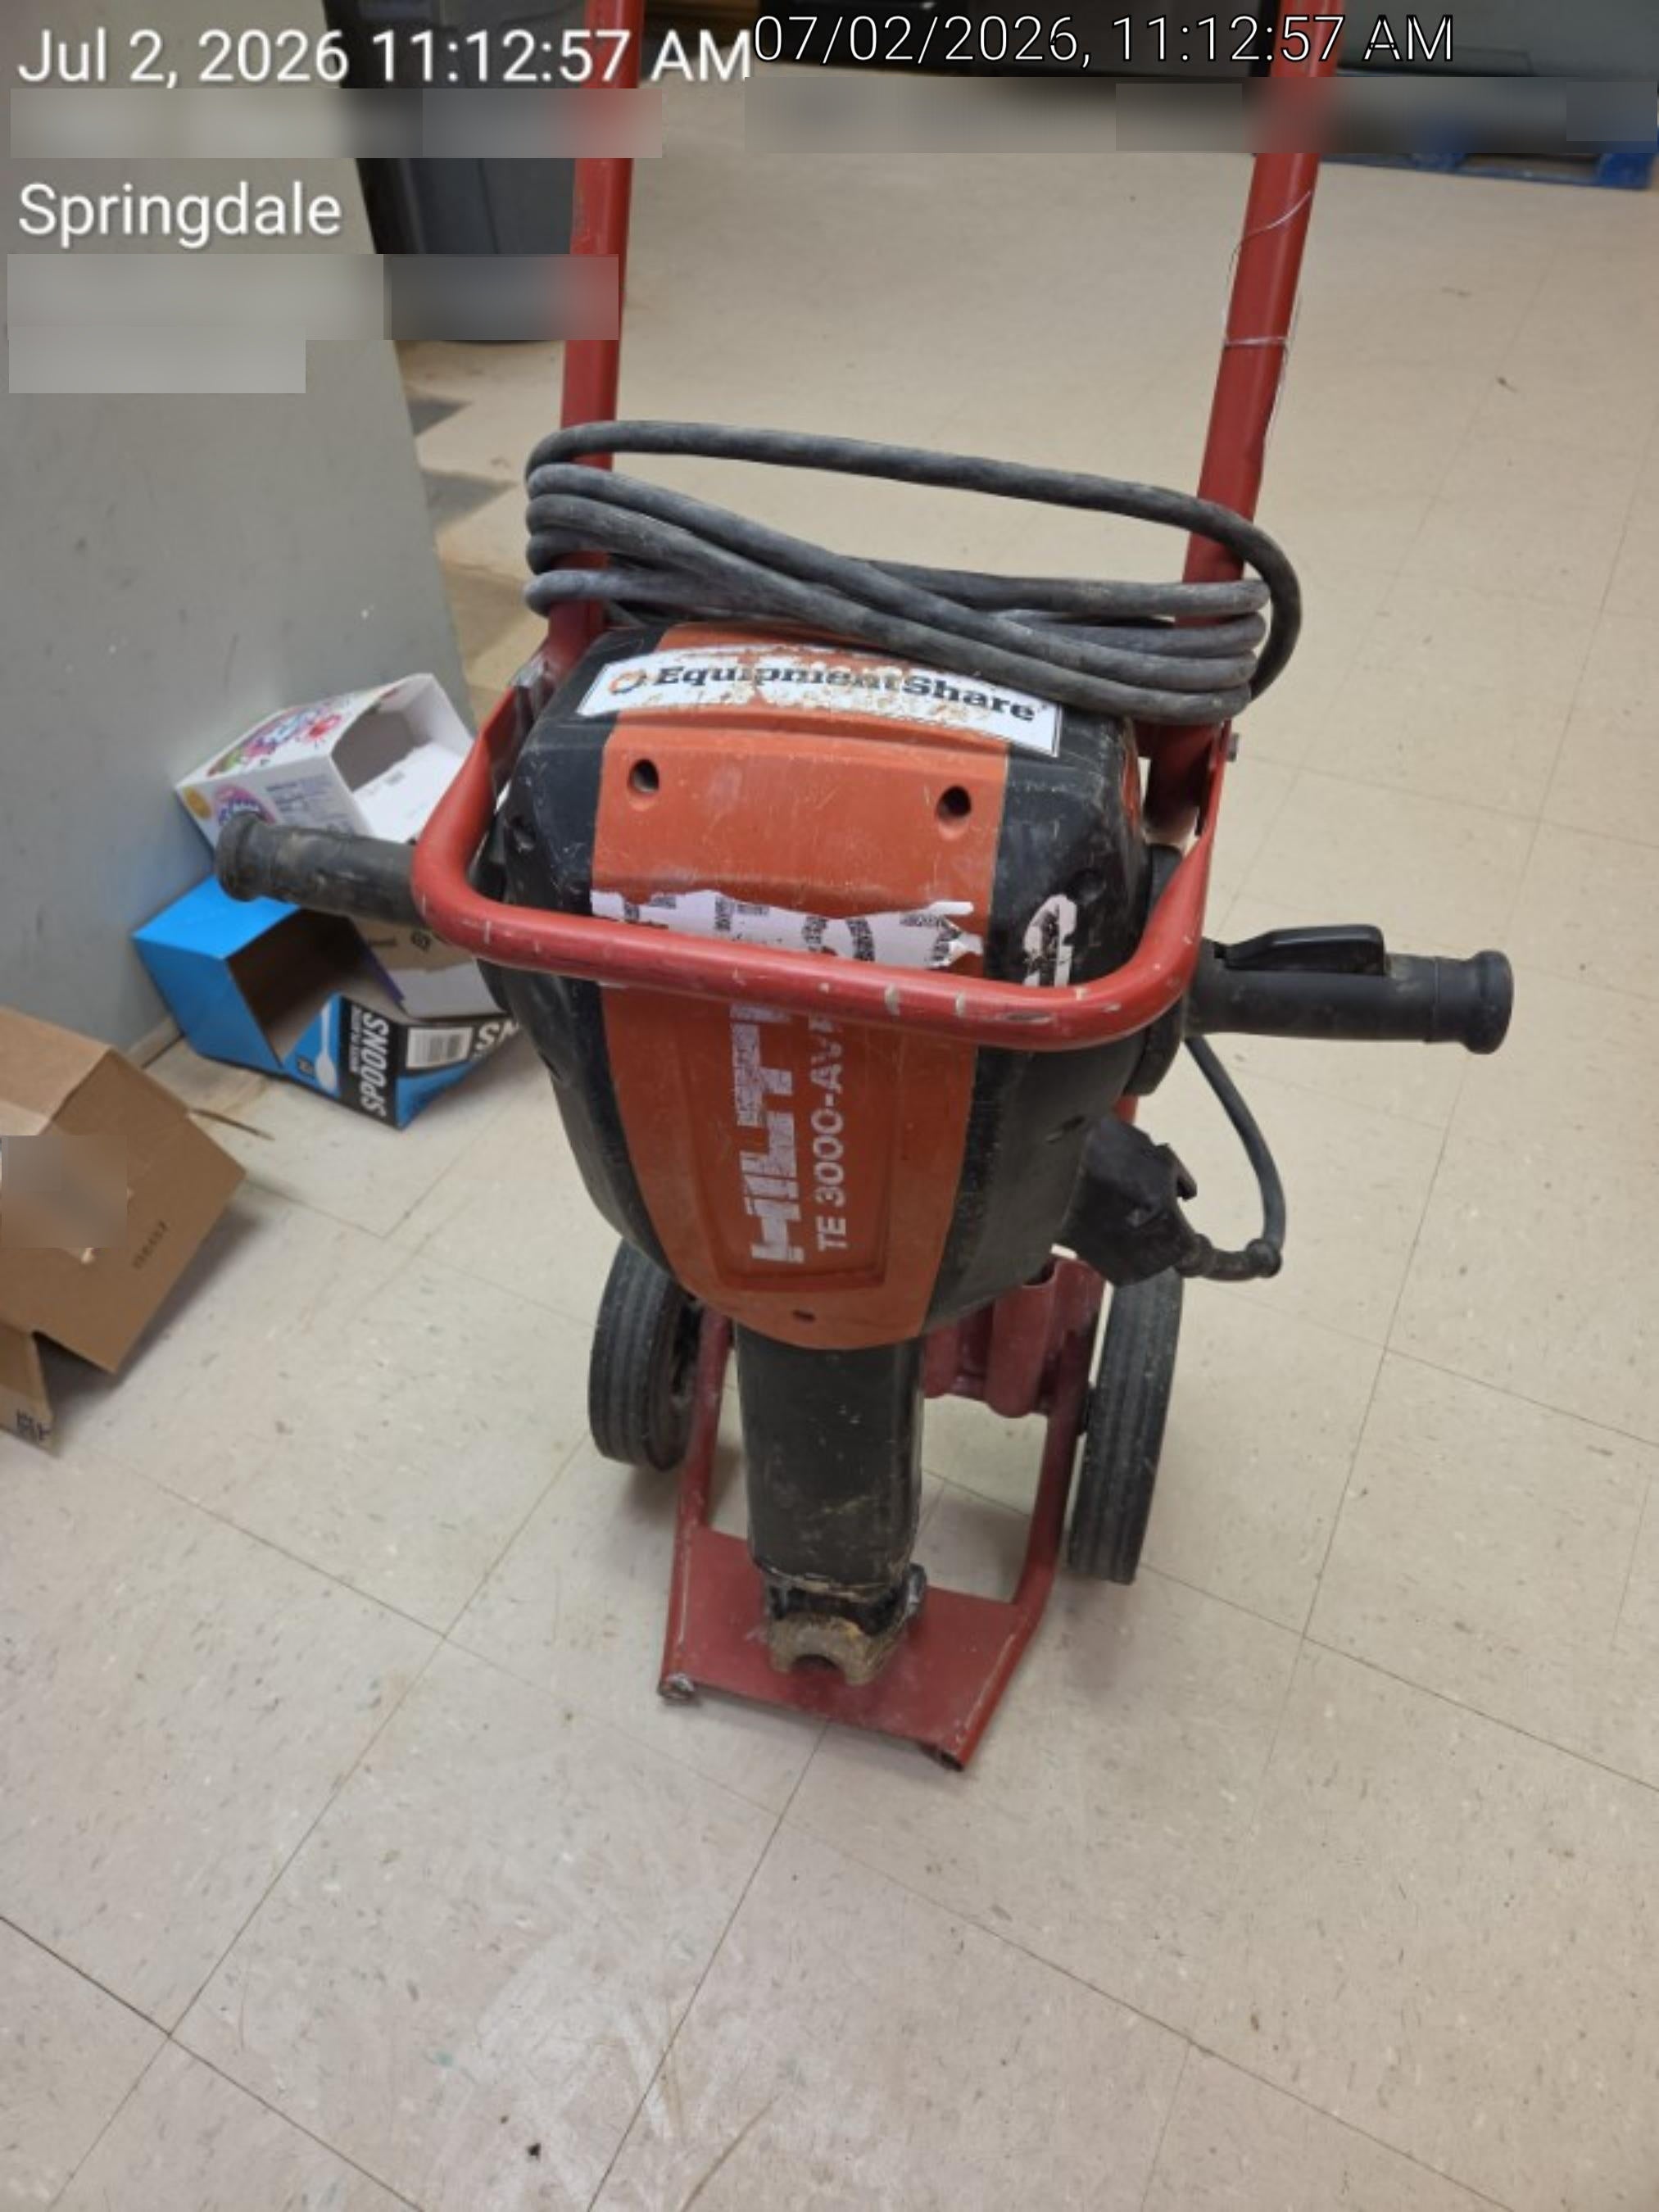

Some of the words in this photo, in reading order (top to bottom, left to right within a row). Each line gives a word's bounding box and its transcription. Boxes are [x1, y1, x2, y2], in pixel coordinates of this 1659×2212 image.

[360, 1011, 389, 1117] SPOONS
[729, 1004, 805, 1263] HILTI
[818, 1216, 849, 1252] TE
